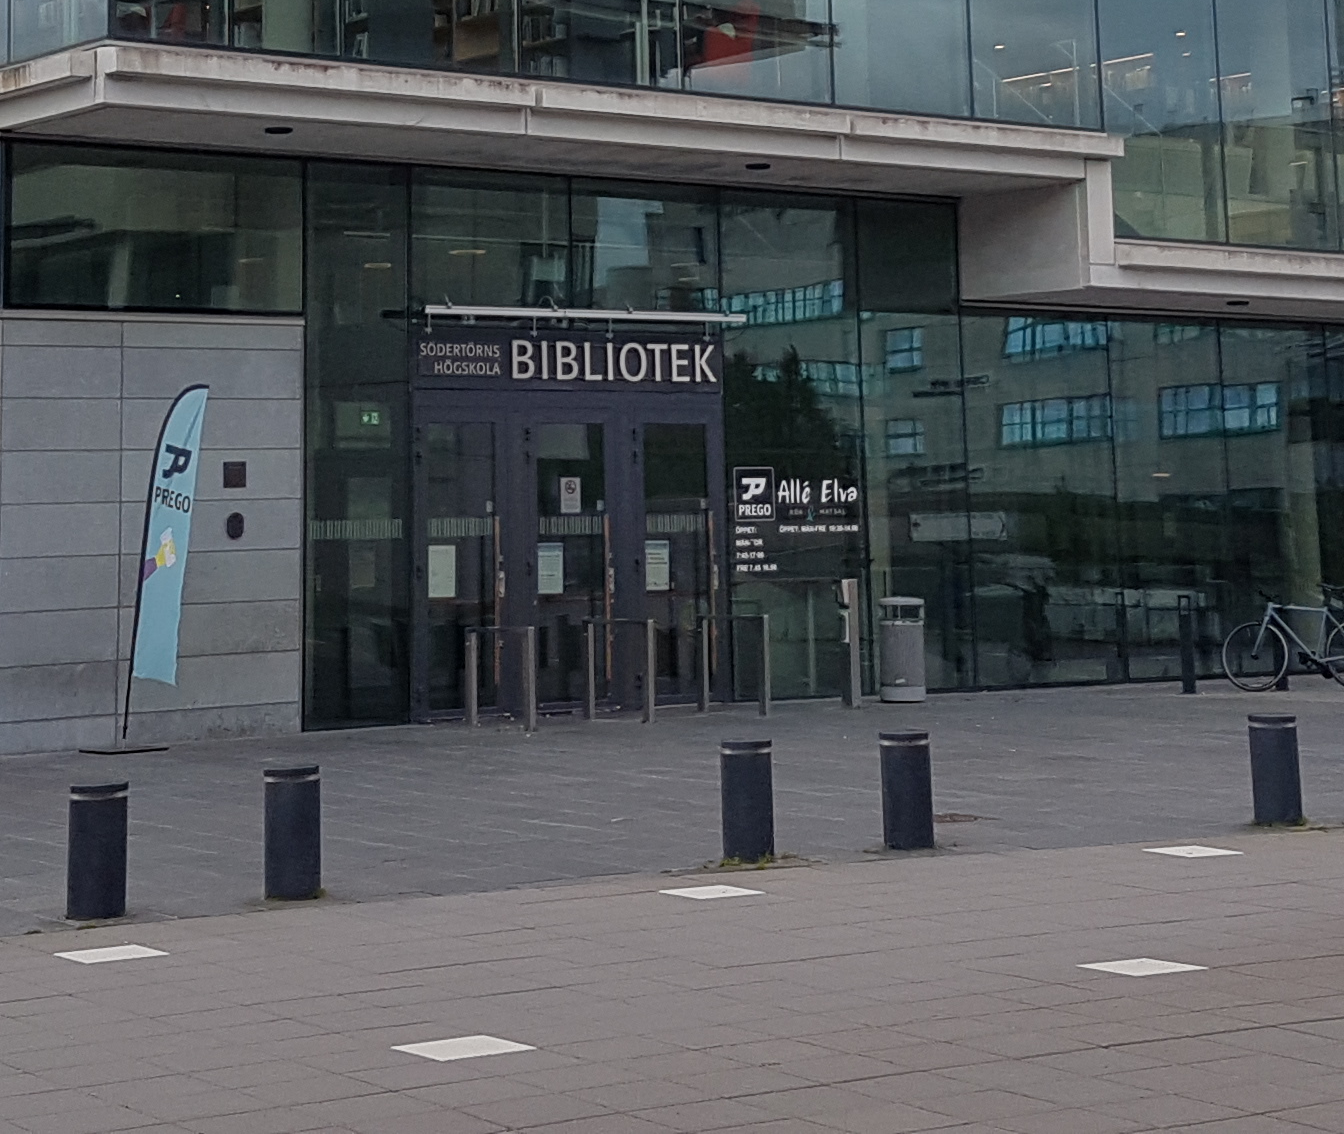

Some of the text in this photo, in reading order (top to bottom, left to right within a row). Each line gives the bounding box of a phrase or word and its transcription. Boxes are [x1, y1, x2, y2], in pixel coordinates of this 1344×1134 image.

[419, 342, 500, 358] SÖDERTÖRNS
[434, 359, 501, 375] HÖGSKOLA
[511, 339, 717, 383] BIBLIOTEK
[154, 486, 192, 514] PREGO
[777, 478, 858, 504] Allé Elva
[738, 504, 772, 516] PREGO
